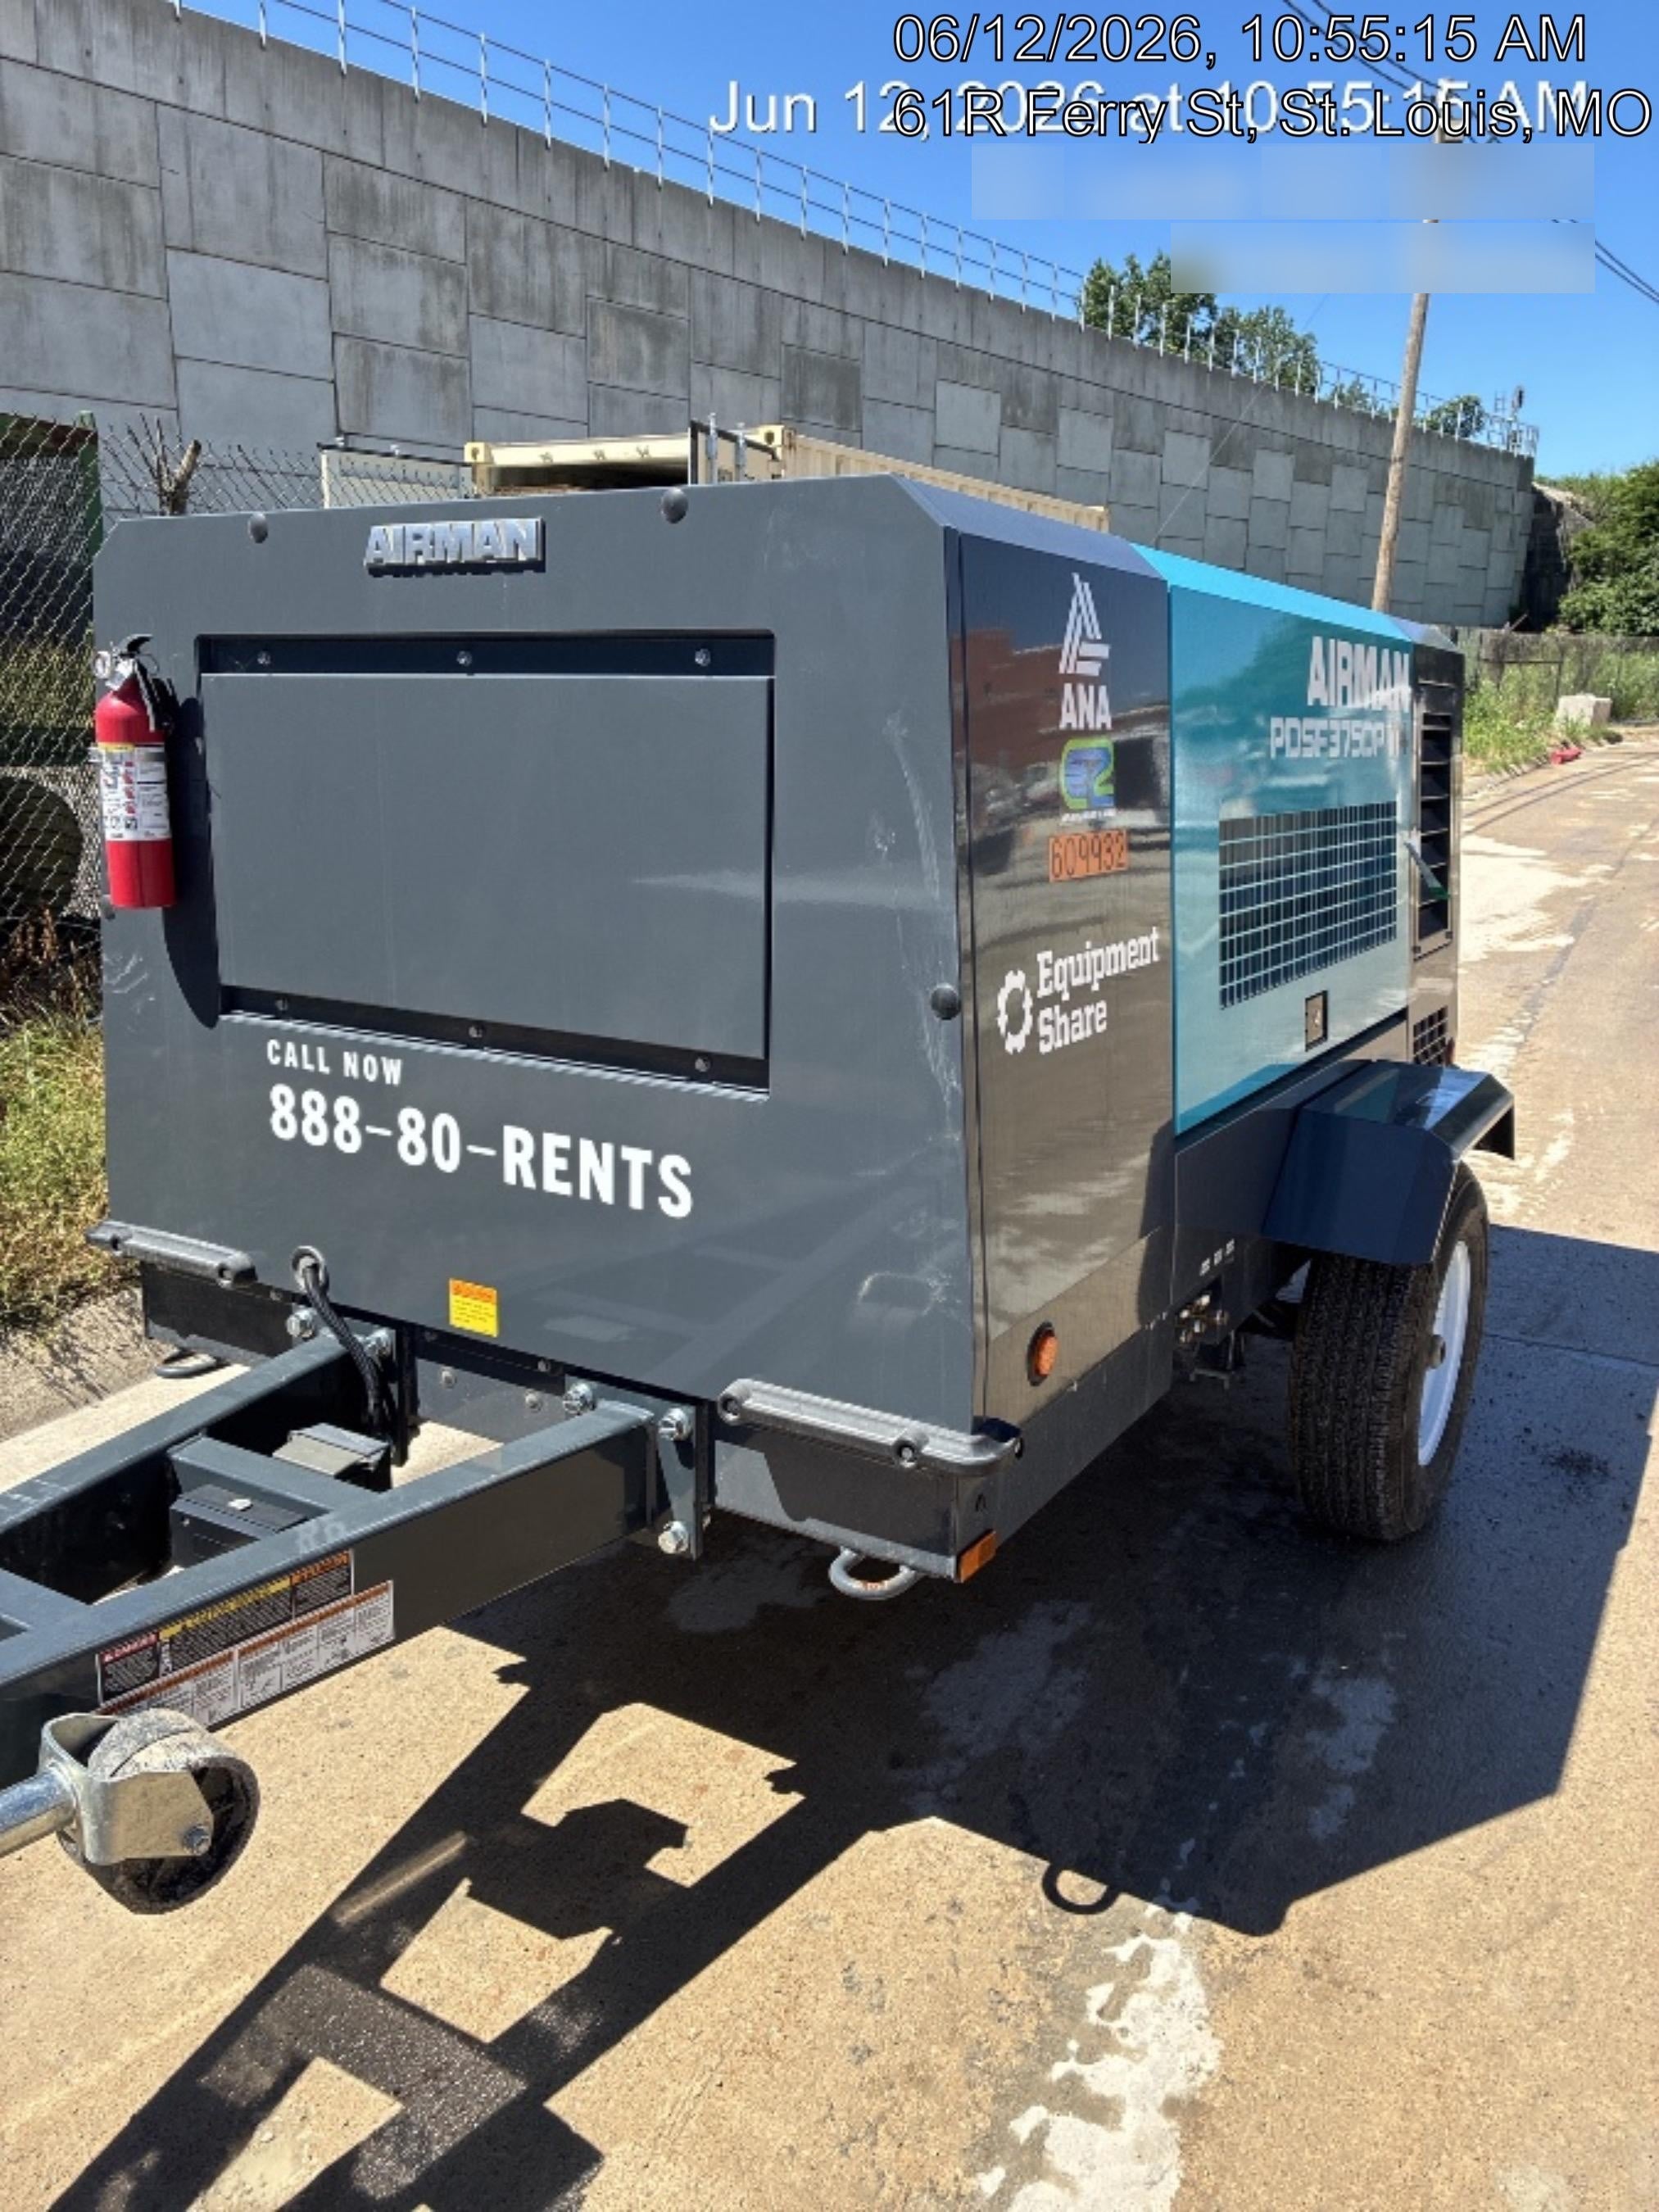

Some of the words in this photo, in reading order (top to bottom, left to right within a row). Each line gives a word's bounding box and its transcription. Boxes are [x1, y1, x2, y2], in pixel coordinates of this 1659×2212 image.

[363, 518, 545, 568] AIRMAN
[1307, 636, 1411, 713] AIRMAN
[1058, 682, 1113, 730] ANA
[1052, 833, 1126, 878] 609932
[1036, 925, 1160, 1001] Equipment
[1038, 999, 1107, 1055] Share
[266, 1039, 330, 1075] CALL
[342, 1050, 404, 1087] NOW
[269, 1083, 694, 1219] 888-80-RENTS
